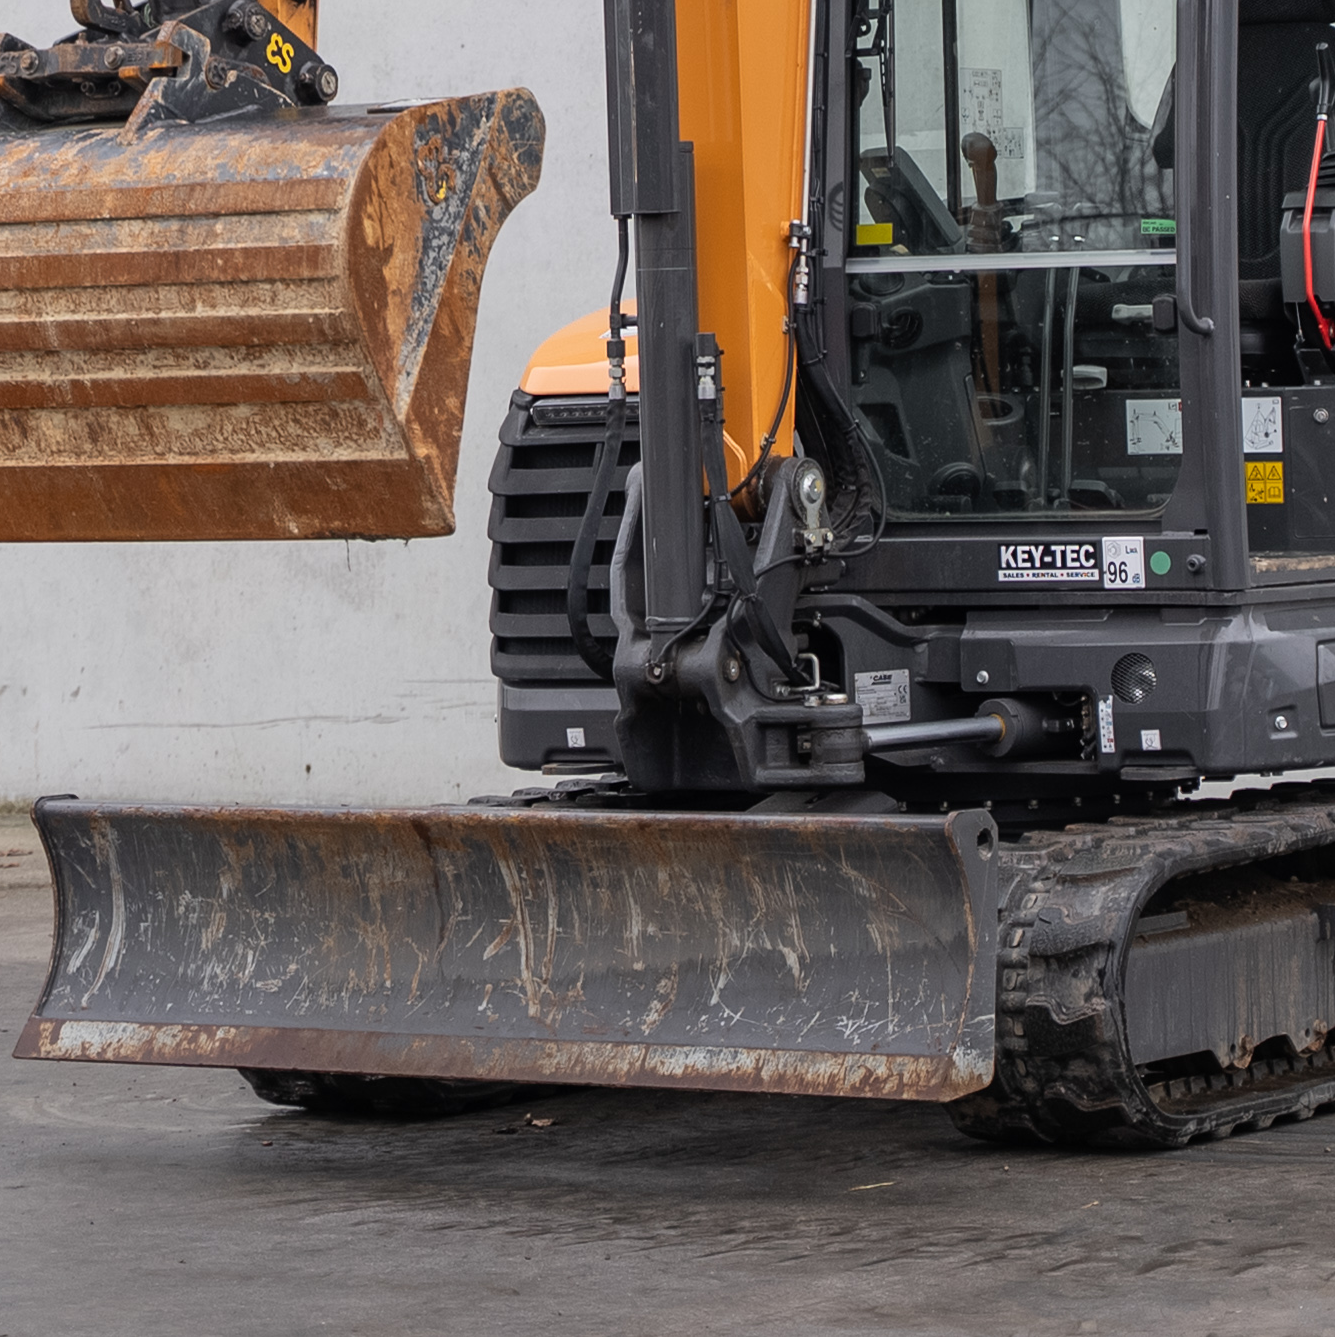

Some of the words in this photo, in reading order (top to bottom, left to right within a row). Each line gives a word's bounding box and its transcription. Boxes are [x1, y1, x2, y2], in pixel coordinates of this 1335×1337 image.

[1000, 544, 1096, 569] KEY-TEC
[1002, 571, 1025, 579] SALES
[1031, 571, 1059, 579] RENTAL
[1066, 570, 1096, 579] SERVICE
[1107, 560, 1129, 584] 96
